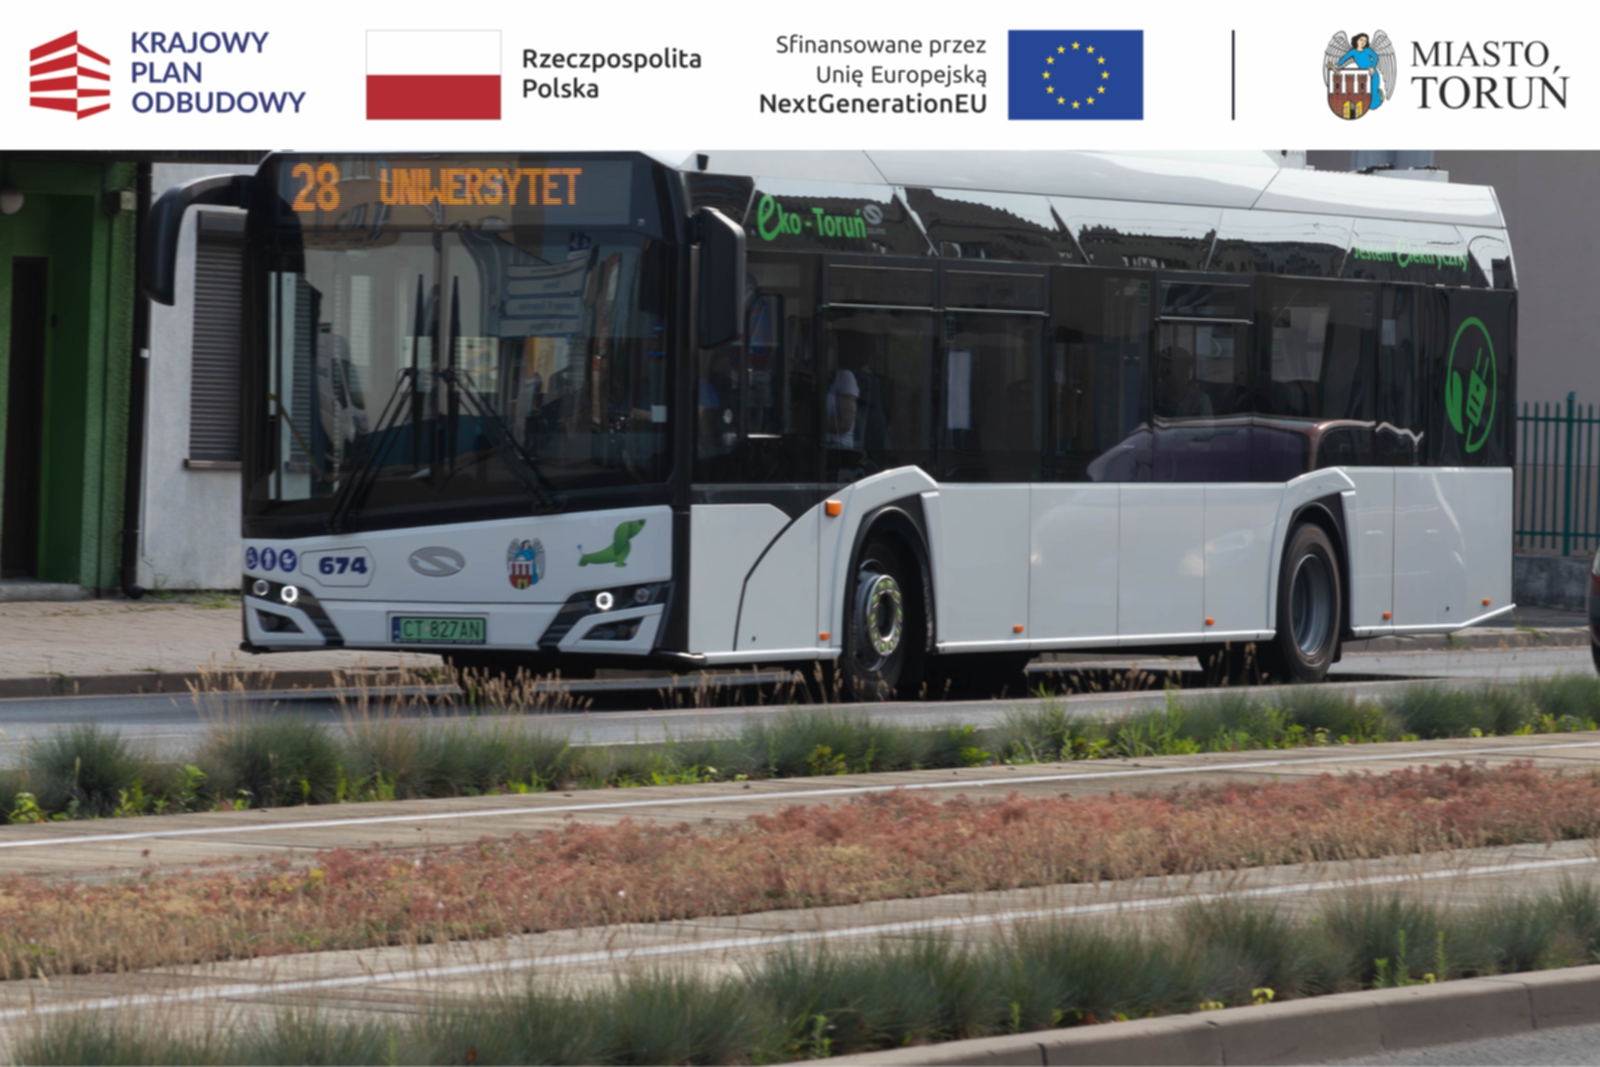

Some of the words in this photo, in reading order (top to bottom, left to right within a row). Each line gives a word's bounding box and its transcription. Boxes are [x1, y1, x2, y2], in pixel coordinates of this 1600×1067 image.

[291, 163, 340, 211] 28
[379, 168, 582, 205] UNIWERSYTET
[319, 556, 368, 575] 674
[403, 620, 423, 638] CT
[430, 620, 480, 638] 827AN
